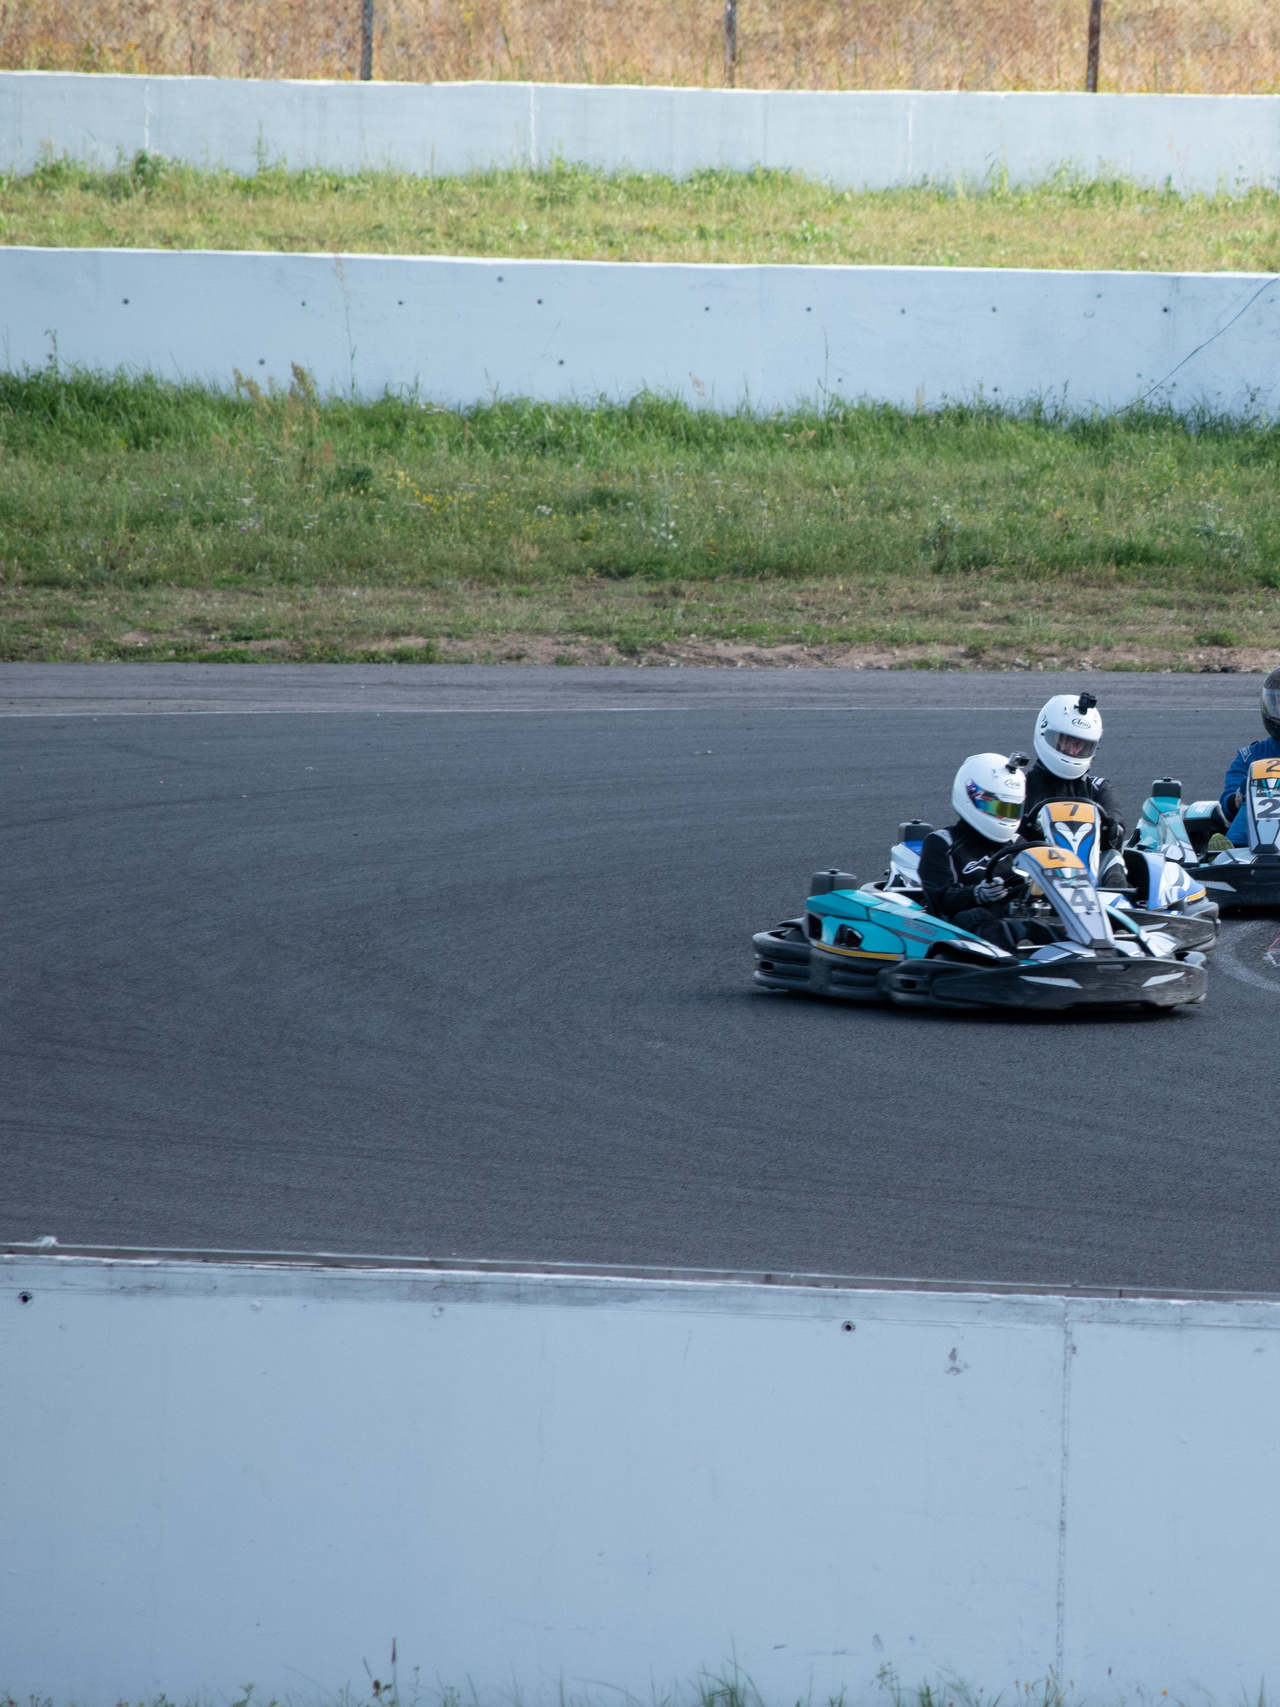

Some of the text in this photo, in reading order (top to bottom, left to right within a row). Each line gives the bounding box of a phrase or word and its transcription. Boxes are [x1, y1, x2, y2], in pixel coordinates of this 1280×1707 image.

[1063, 803, 1080, 817] 7
[1047, 848, 1066, 862] 4
[1070, 889, 1096, 911] 4
